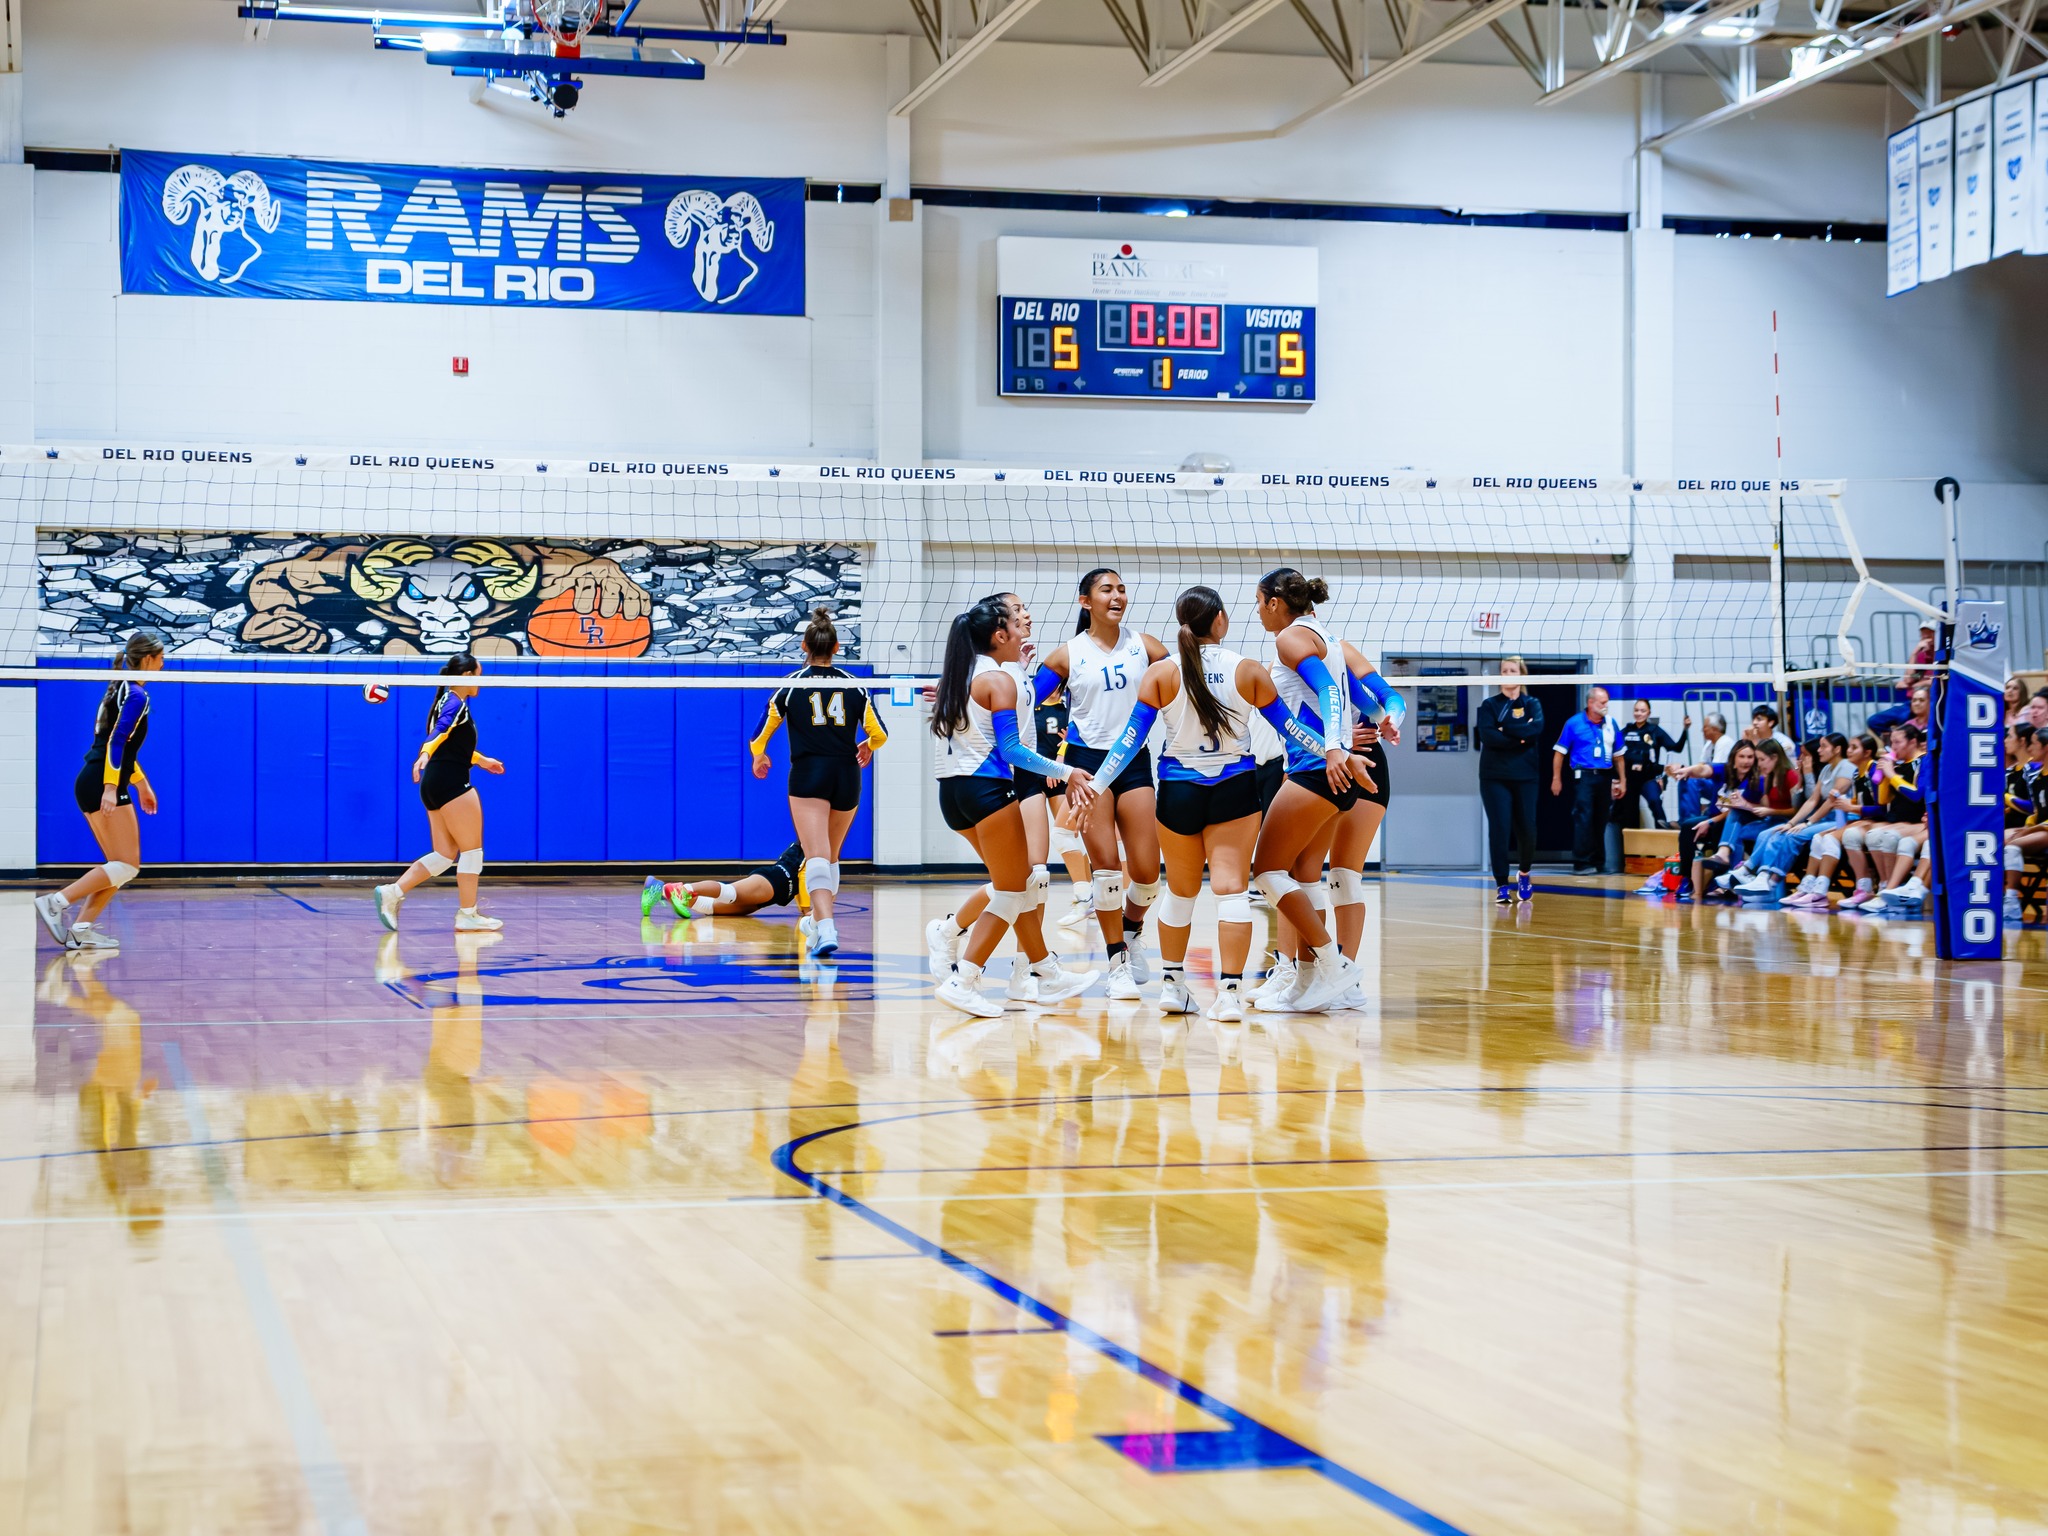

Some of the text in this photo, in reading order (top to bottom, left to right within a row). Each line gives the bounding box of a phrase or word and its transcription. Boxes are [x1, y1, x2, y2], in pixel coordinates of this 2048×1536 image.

[306, 171, 642, 263] RAMS
[1092, 261, 1148, 278] BANK
[366, 259, 595, 301] DEL RIO
[1013, 301, 1080, 322] DEL RIO
[1245, 308, 1303, 329] VISITOR
[1177, 368, 1209, 380] PERIOD
[102, 448, 252, 464] DEL RIO QUEENS
[350, 455, 495, 470] DEL RIO QUEENS
[588, 461, 729, 477] DEL RIO QUEENS
[819, 466, 956, 481] DEL RIO QUEENS
[1044, 470, 1176, 485] DEL RIO QUEENS
[1261, 474, 1390, 489] DEL RIO QUEENS
[1472, 477, 1598, 491] DEL RIO QUEENS
[1678, 479, 1800, 493] DEL RIO QUENS
[1479, 612, 1500, 629] EXIT
[1101, 663, 1127, 692] 15
[1204, 673, 1225, 684] EENS
[808, 691, 846, 727] 14
[1328, 685, 1342, 730] QUEENS
[1045, 716, 1059, 735] 2
[1284, 718, 1327, 756] QUEENS
[1103, 725, 1138, 776] DEL RIO
[1963, 694, 1998, 943] DEL RIO
